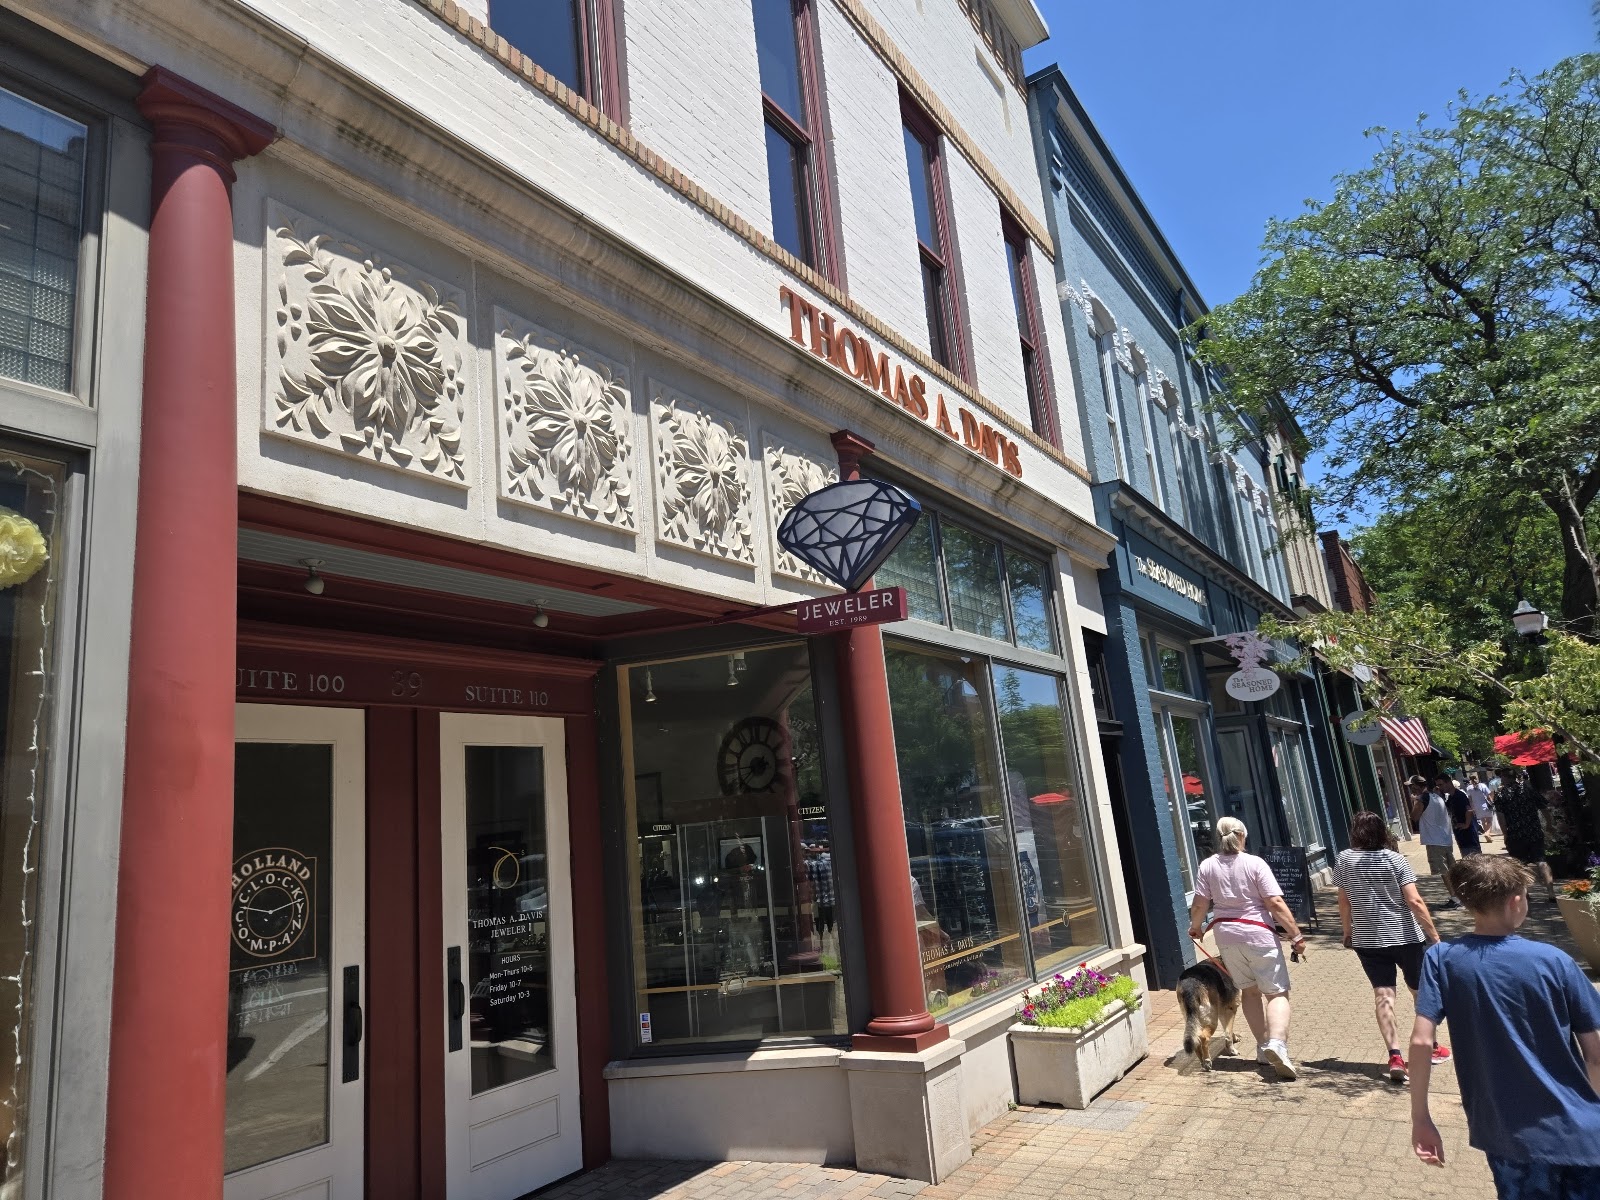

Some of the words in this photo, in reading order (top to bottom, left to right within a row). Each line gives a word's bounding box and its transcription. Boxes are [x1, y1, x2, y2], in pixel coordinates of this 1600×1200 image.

[779, 285, 928, 420] THOMAS
[935, 393, 959, 441] A.
[959, 407, 1022, 478] DAVIS
[802, 592, 894, 621] JEWELER
[829, 619, 847, 627] EST.
[236, 668, 298, 691] UITE
[309, 674, 345, 693] 100
[392, 670, 423, 698] 39
[1231, 678, 1273, 689] SEASONED
[1249, 684, 1274, 693] HOME
[465, 685, 523, 704] SUITE
[529, 690, 549, 706] 110
[797, 805, 826, 816] CITIZEN
[652, 823, 672, 832] CITIZEN
[232, 854, 311, 889] HOLLAND
[472, 916, 506, 929] THOMAS
[509, 915, 518, 923] A.
[520, 910, 543, 922] DAVIS
[490, 925, 526, 939] JEWELER
[921, 944, 949, 963] THOMAS
[957, 936, 974, 951] DAVIS
[501, 953, 521, 965] HOURS
[489, 968, 520, 980] Mon-Thurs
[520, 964, 533, 973] 10-5
[489, 983, 508, 994] Friday
[509, 979, 522, 989] 10-7
[489, 994, 517, 1007] Saturday
[518, 990, 531, 1000] 10-3
